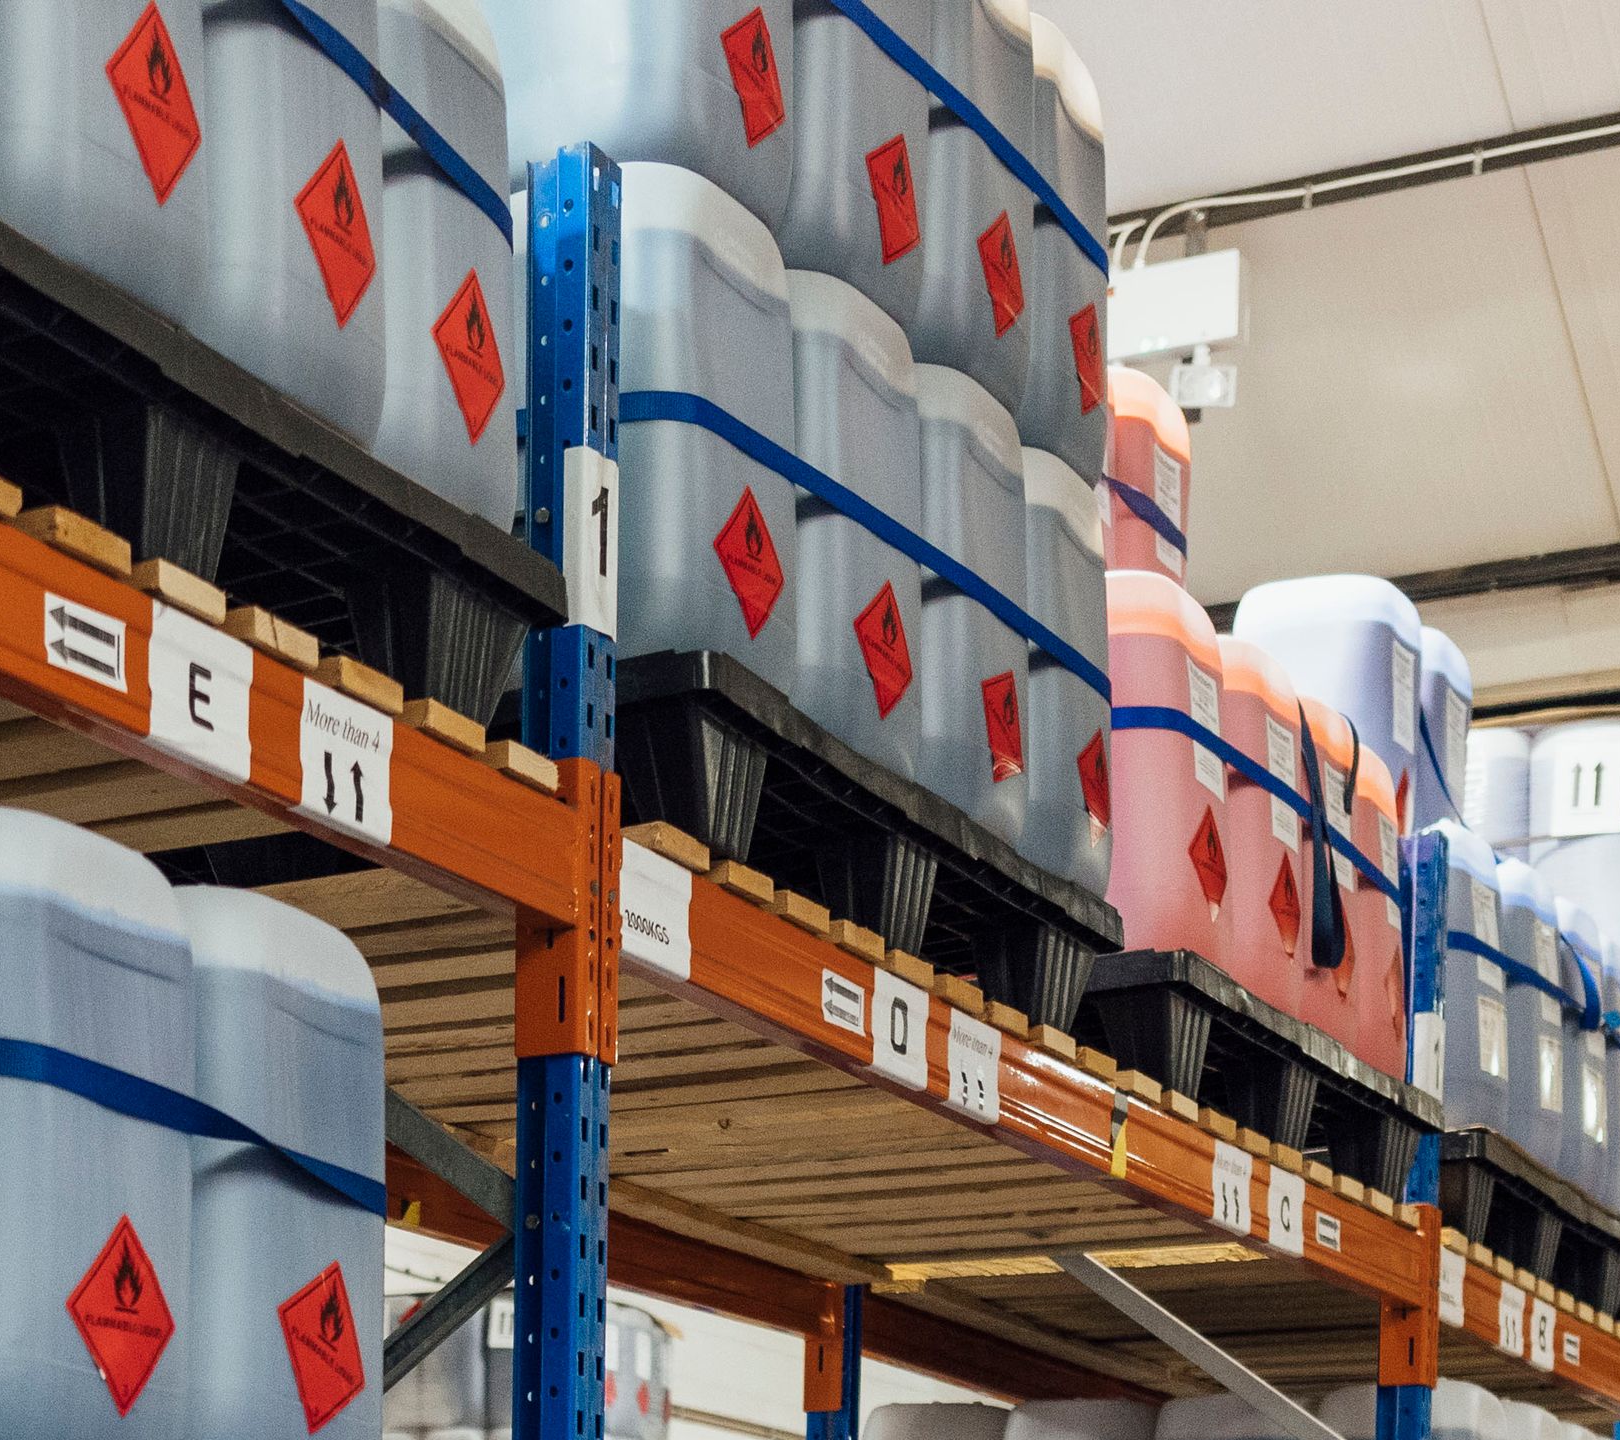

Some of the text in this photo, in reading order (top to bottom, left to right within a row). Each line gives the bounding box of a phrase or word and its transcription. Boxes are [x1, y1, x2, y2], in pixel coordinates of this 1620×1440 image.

[591, 486, 609, 577] 1
[187, 662, 215, 731] E
[305, 699, 380, 752] More than 4
[624, 909, 670, 946] 2000KGS
[1280, 1196, 1290, 1233] C
